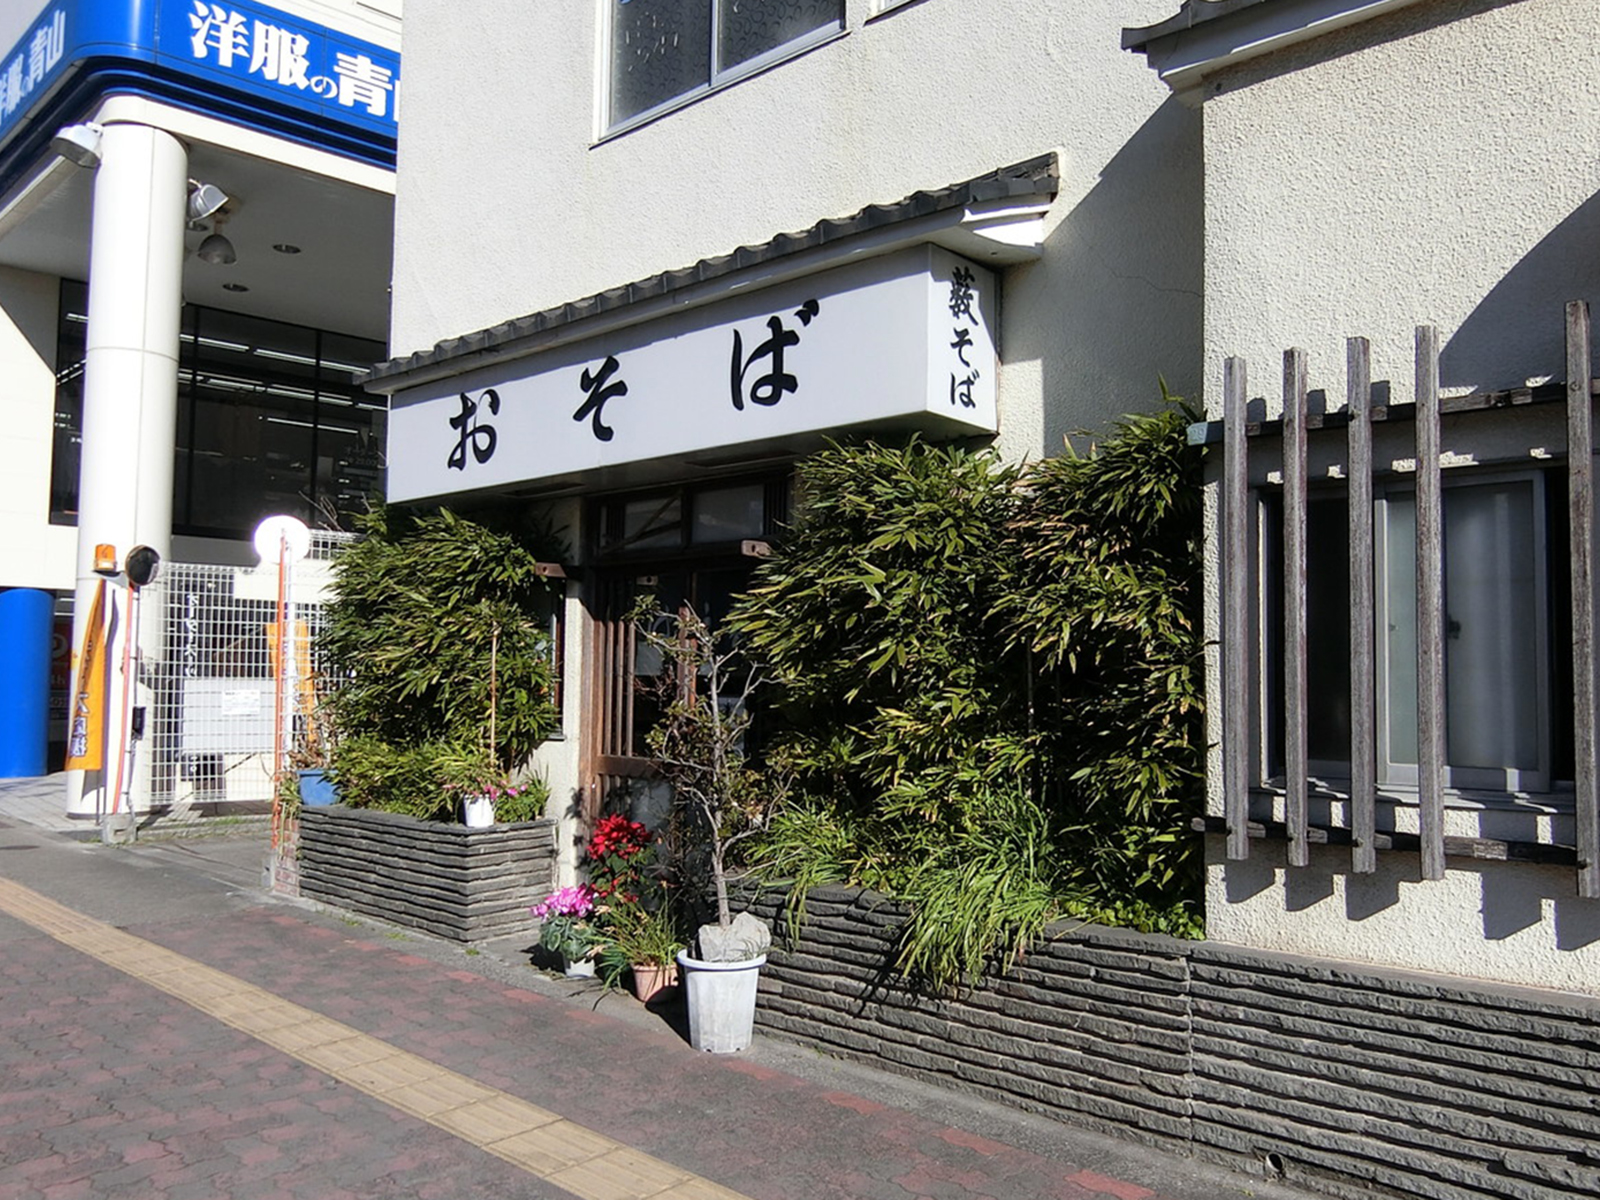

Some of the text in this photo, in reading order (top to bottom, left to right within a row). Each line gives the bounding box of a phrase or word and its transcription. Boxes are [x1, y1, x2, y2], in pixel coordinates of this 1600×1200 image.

[188, 0, 400, 122] 洋服の青
[447, 299, 820, 471] おそば
